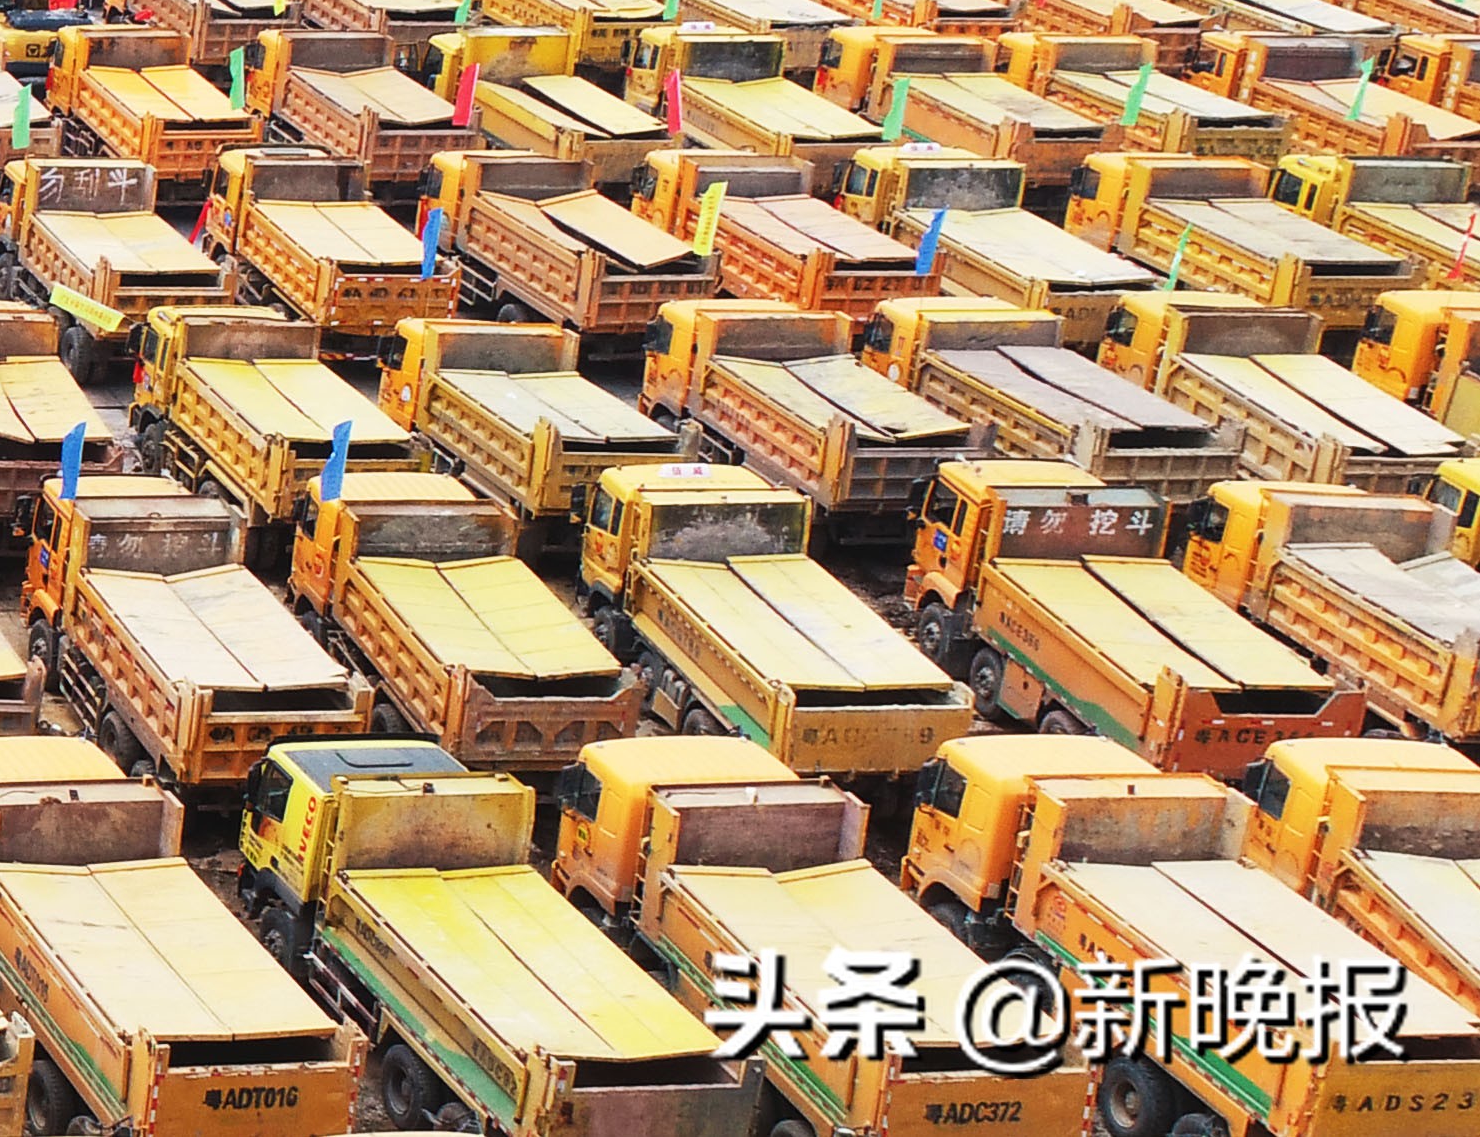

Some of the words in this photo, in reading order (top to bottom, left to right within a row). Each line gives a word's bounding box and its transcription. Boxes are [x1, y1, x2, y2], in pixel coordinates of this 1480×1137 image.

[1003, 510, 1153, 536] 请勿挖斗
[297, 796, 317, 863] IVECO
[204, 1086, 298, 1110] 粤ADT016
[924, 1101, 1022, 1124] 粤ADC372
